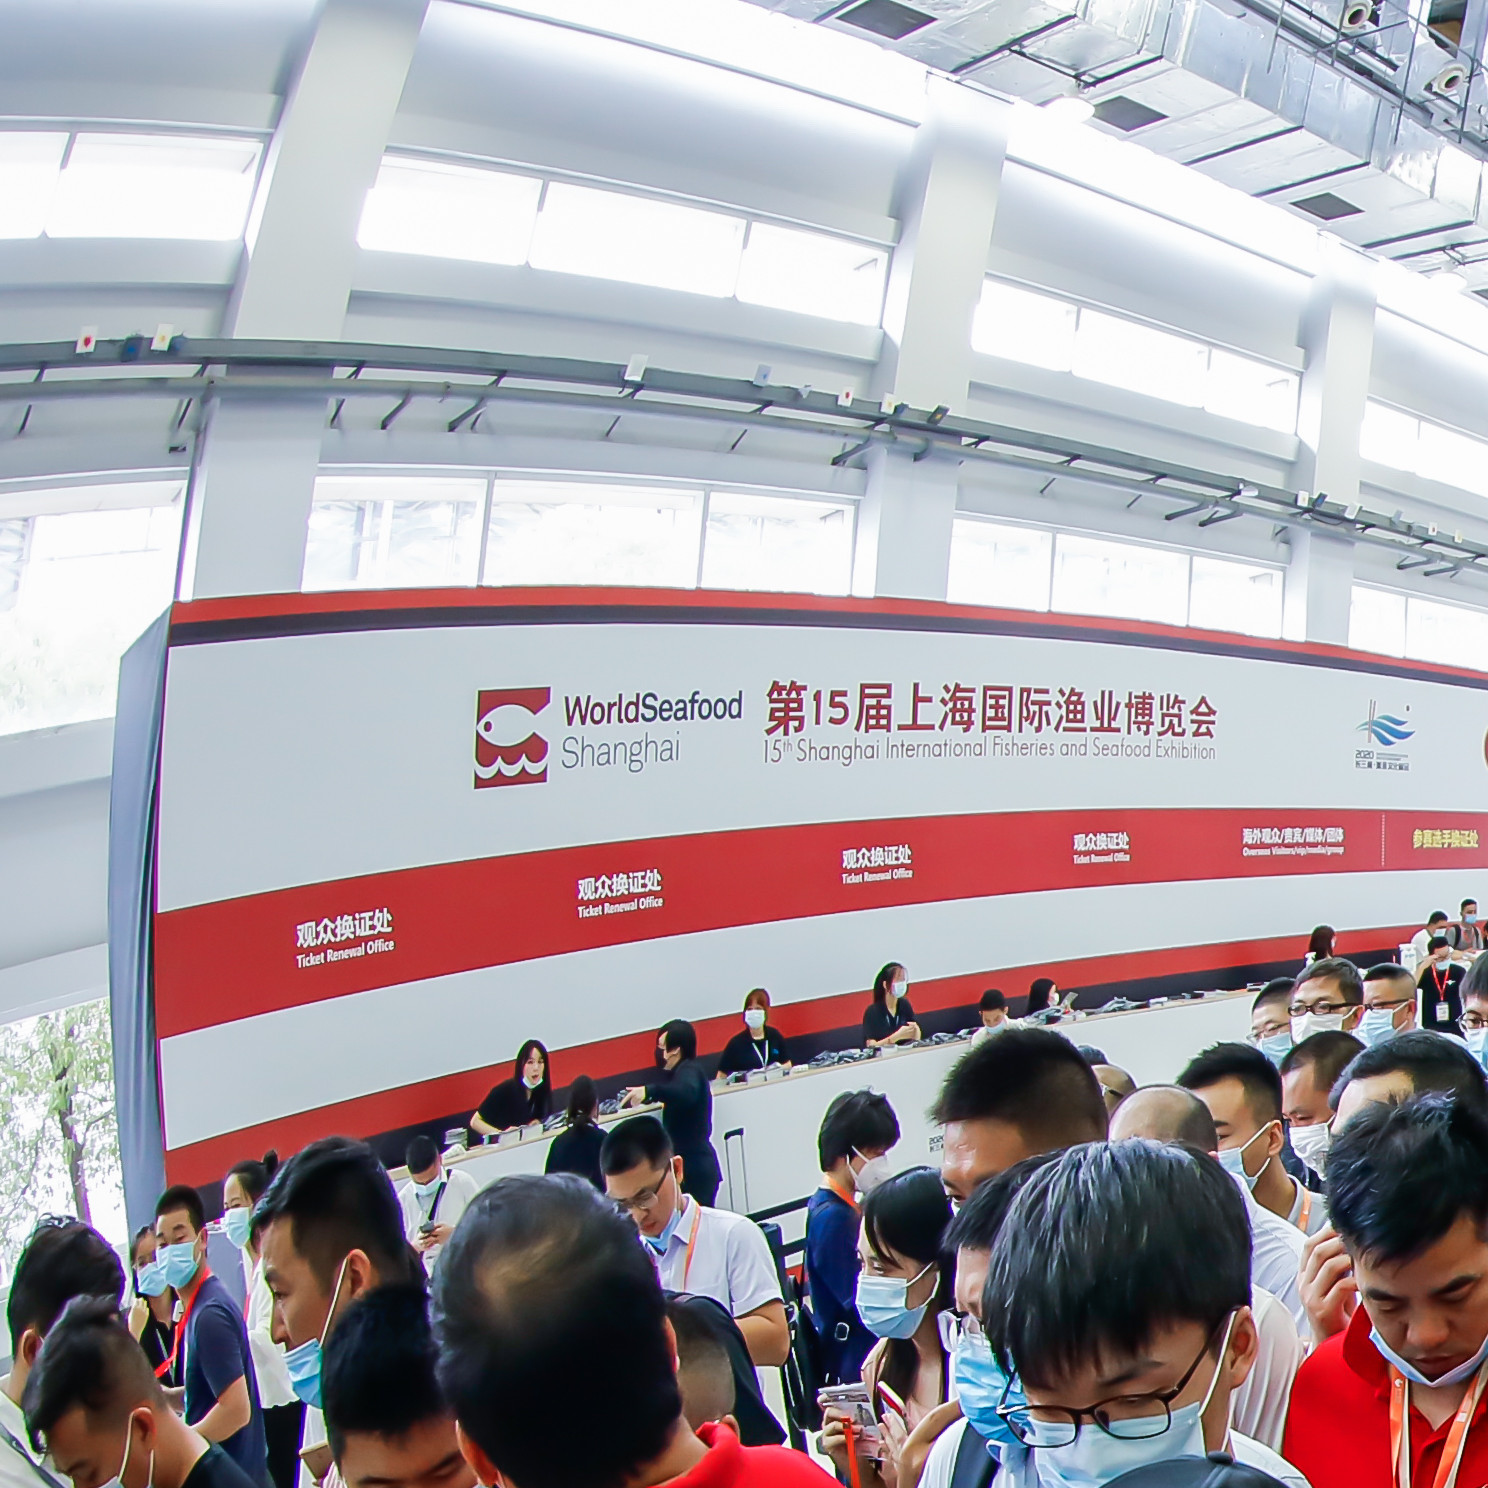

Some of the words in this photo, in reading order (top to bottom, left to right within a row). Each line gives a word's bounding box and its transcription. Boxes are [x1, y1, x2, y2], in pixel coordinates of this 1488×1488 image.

[565, 690, 743, 727] WorldSeafood
[764, 680, 1218, 739] 第15届上海国际渔业博览会
[561, 731, 681, 774] Shanghai
[763, 738, 793, 764] 15th
[796, 738, 880, 768] Shanghai
[886, 736, 987, 760] International
[993, 734, 1055, 758] Fisheries
[1060, 738, 1088, 757] and
[1092, 737, 1151, 759] Seafood
[1155, 738, 1217, 761] Exhibition
[1073, 831, 1130, 851] 观众换证处
[1243, 827, 1345, 845] 海外观众/贵宾/媒体/团体
[842, 844, 912, 869] 观众换证处
[577, 868, 662, 901] 观众换证处
[842, 872, 863, 884] Ticket
[864, 870, 891, 882] Renewal
[893, 867, 914, 879] Office
[577, 902, 603, 919] Ticket
[603, 898, 638, 915] Renewal
[639, 894, 664, 909] Office
[296, 907, 393, 949] 观众换证处
[296, 949, 325, 969] Ticket
[326, 942, 365, 963] Renewal
[366, 937, 395, 955] Office
